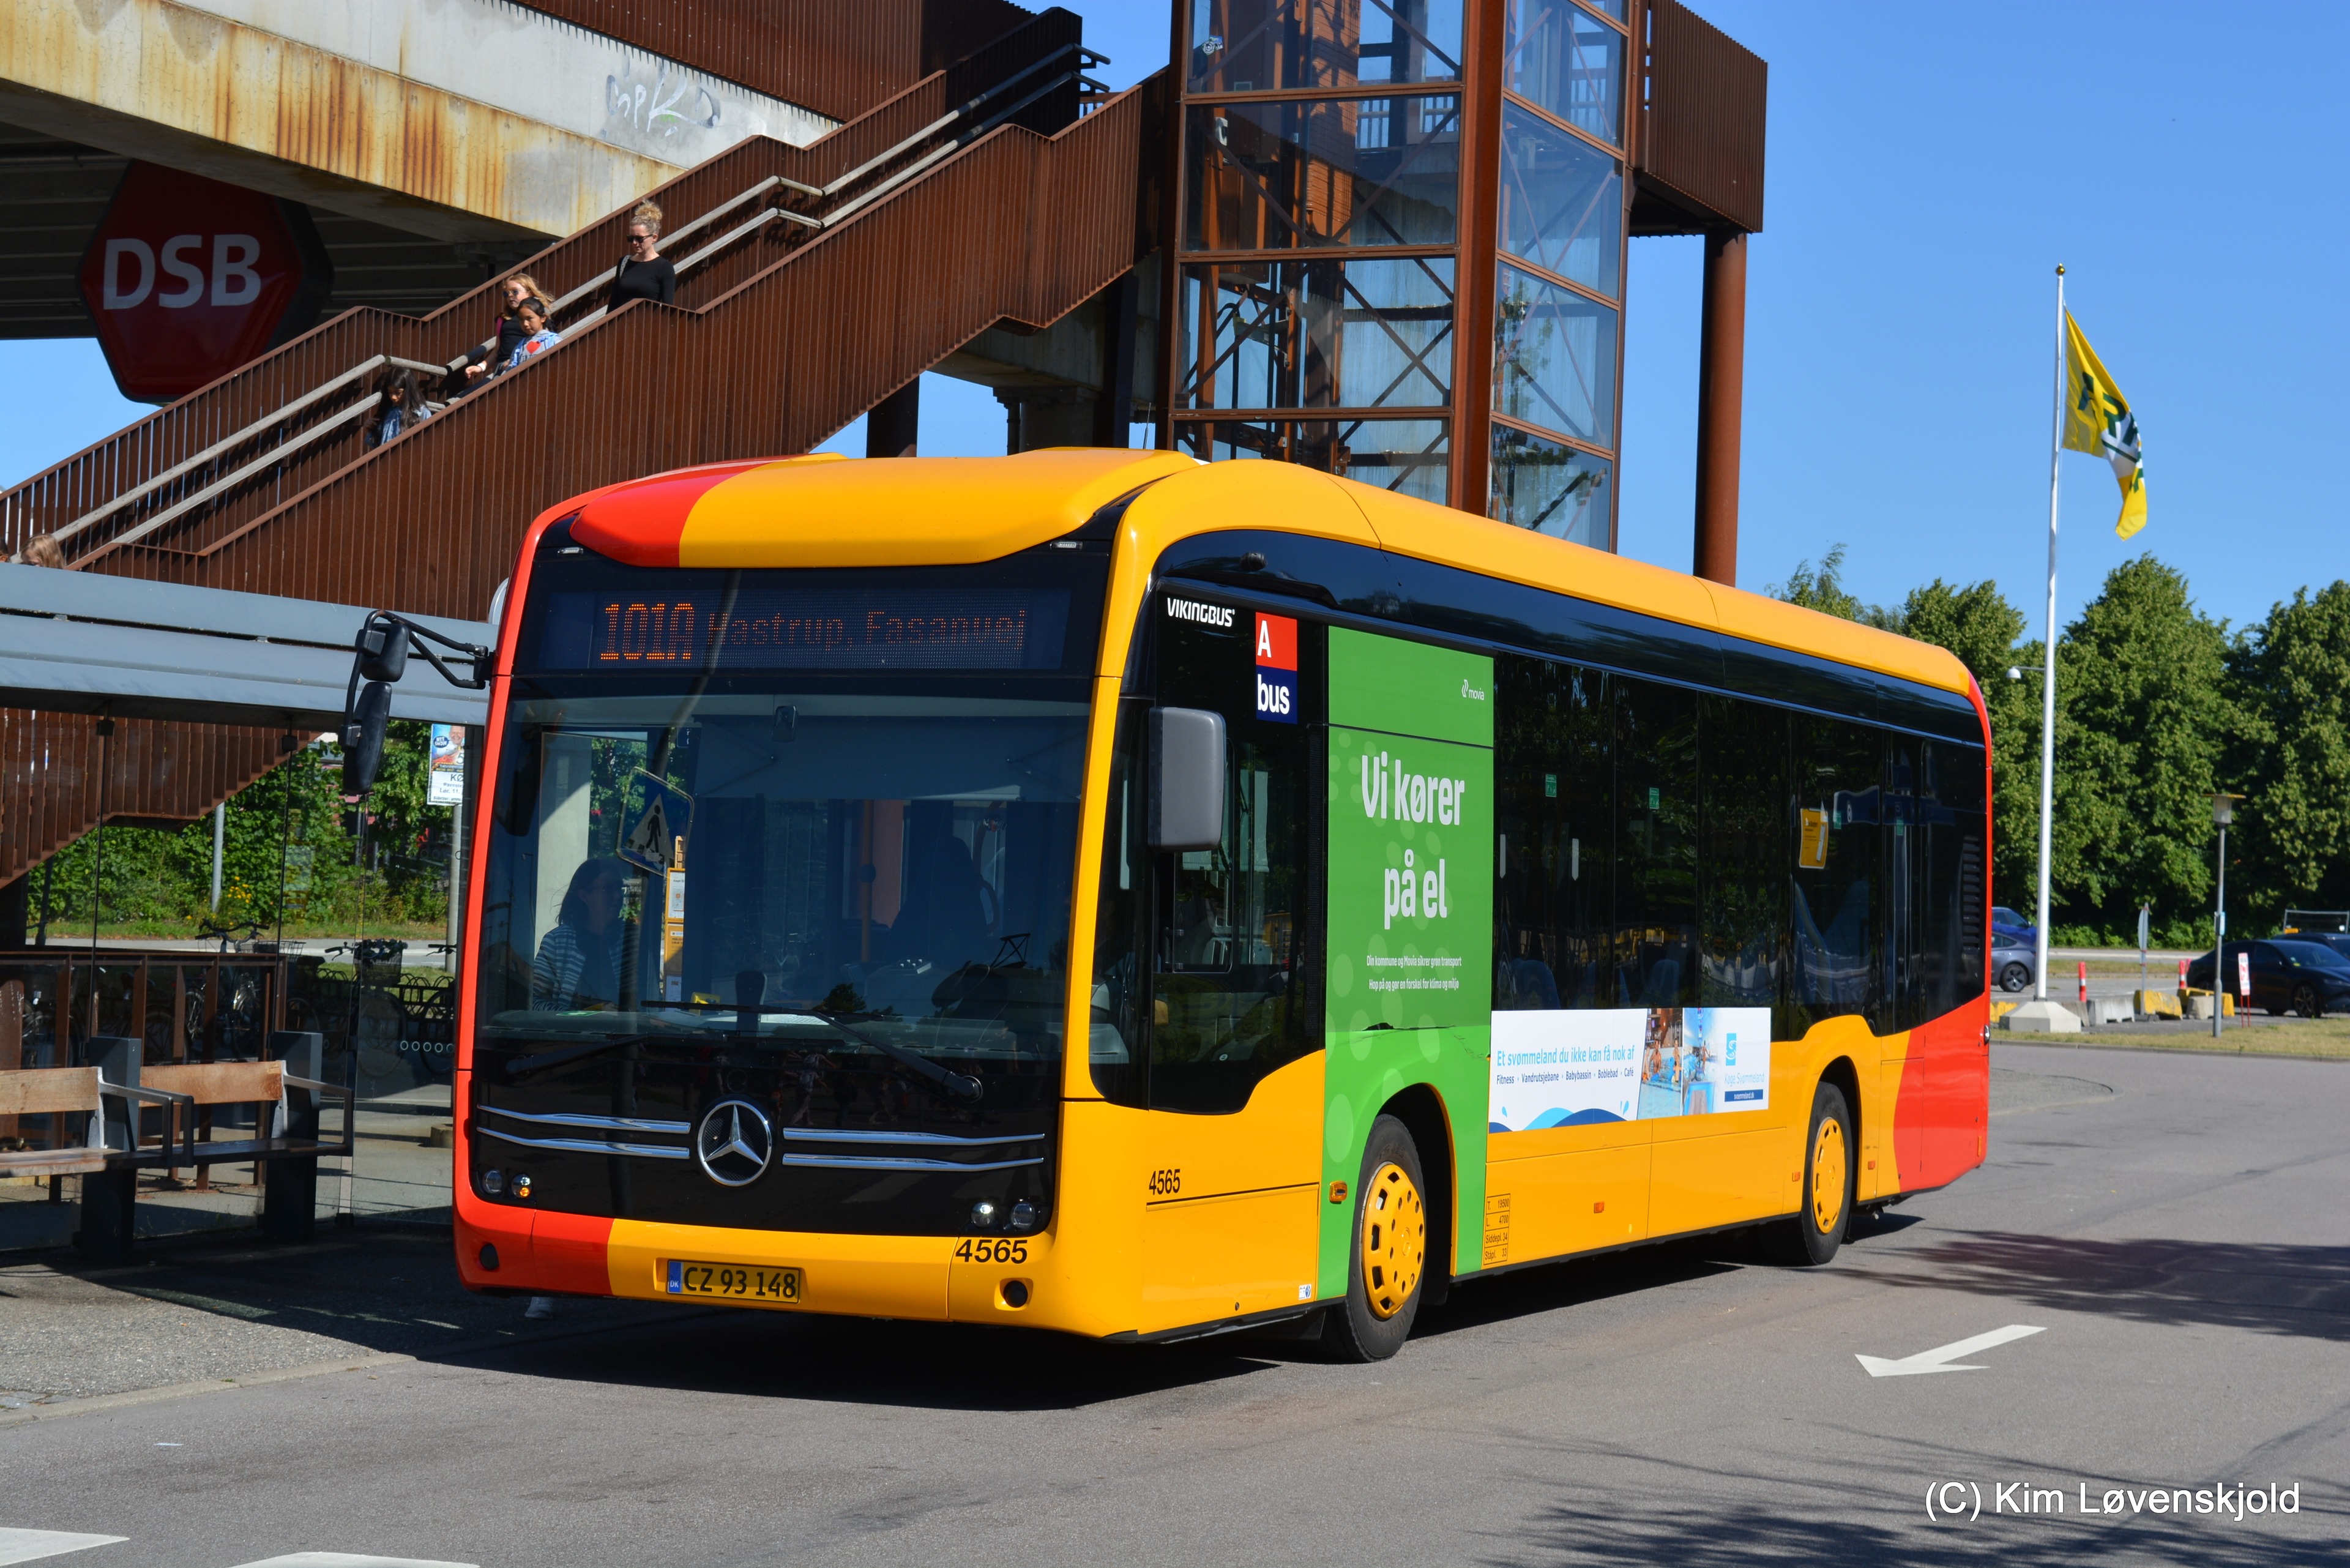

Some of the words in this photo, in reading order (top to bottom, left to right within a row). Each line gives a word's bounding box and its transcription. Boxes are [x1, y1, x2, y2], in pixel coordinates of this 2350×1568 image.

[103, 234, 261, 310] DSB
[707, 613, 852, 651] Hastrup,
[867, 610, 1025, 651] Fasanvej
[1257, 620, 1272, 658] A
[1258, 674, 1290, 715] bus
[1469, 687, 1484, 700] movia
[1362, 751, 1387, 819] Vi
[1395, 759, 1464, 826] kører
[1384, 849, 1416, 930] på
[1423, 859, 1447, 918] el
[1375, 955, 1397, 966] kommune
[1398, 958, 1403, 968] og
[1404, 955, 1417, 966] Movia
[1417, 955, 1430, 966] sikrer
[1441, 957, 1461, 968] transport
[1369, 979, 1378, 991] Hop
[1379, 978, 1384, 991] på
[1385, 981, 1391, 991] og
[1406, 978, 1422, 989] forskel
[1430, 978, 1442, 989] klima
[1442, 981, 1448, 991] og
[1448, 977, 1459, 991] miljø
[1497, 1050, 1505, 1066] Et
[1507, 1047, 1557, 1067] svømmeland
[1559, 1047, 1569, 1064] du
[1571, 1047, 1586, 1062] ikke
[1589, 1047, 1602, 1062] kan
[1604, 1045, 1610, 1061] få
[1613, 1045, 1625, 1061] nok
[1627, 1045, 1635, 1060] af
[1497, 1075, 1514, 1085] Fitness
[1521, 1072, 1559, 1085] Vandrutsjebane
[1565, 1070, 1591, 1082] Babybassin
[1598, 1068, 1618, 1078] Boblebad
[1624, 1067, 1633, 1077] Café
[1149, 1168, 1181, 1195] 4565
[1498, 1198, 1509, 1209] 19500
[1499, 1214, 1509, 1224] 4700
[1485, 1232, 1502, 1244] Siddepl.
[1503, 1233, 1507, 1241] 34
[955, 1239, 1028, 1264] 4565
[1502, 1248, 1507, 1256] 33
[670, 1280, 679, 1288] DK
[684, 1267, 714, 1292] CZ
[720, 1269, 747, 1294] 93
[756, 1272, 796, 1298] 148
